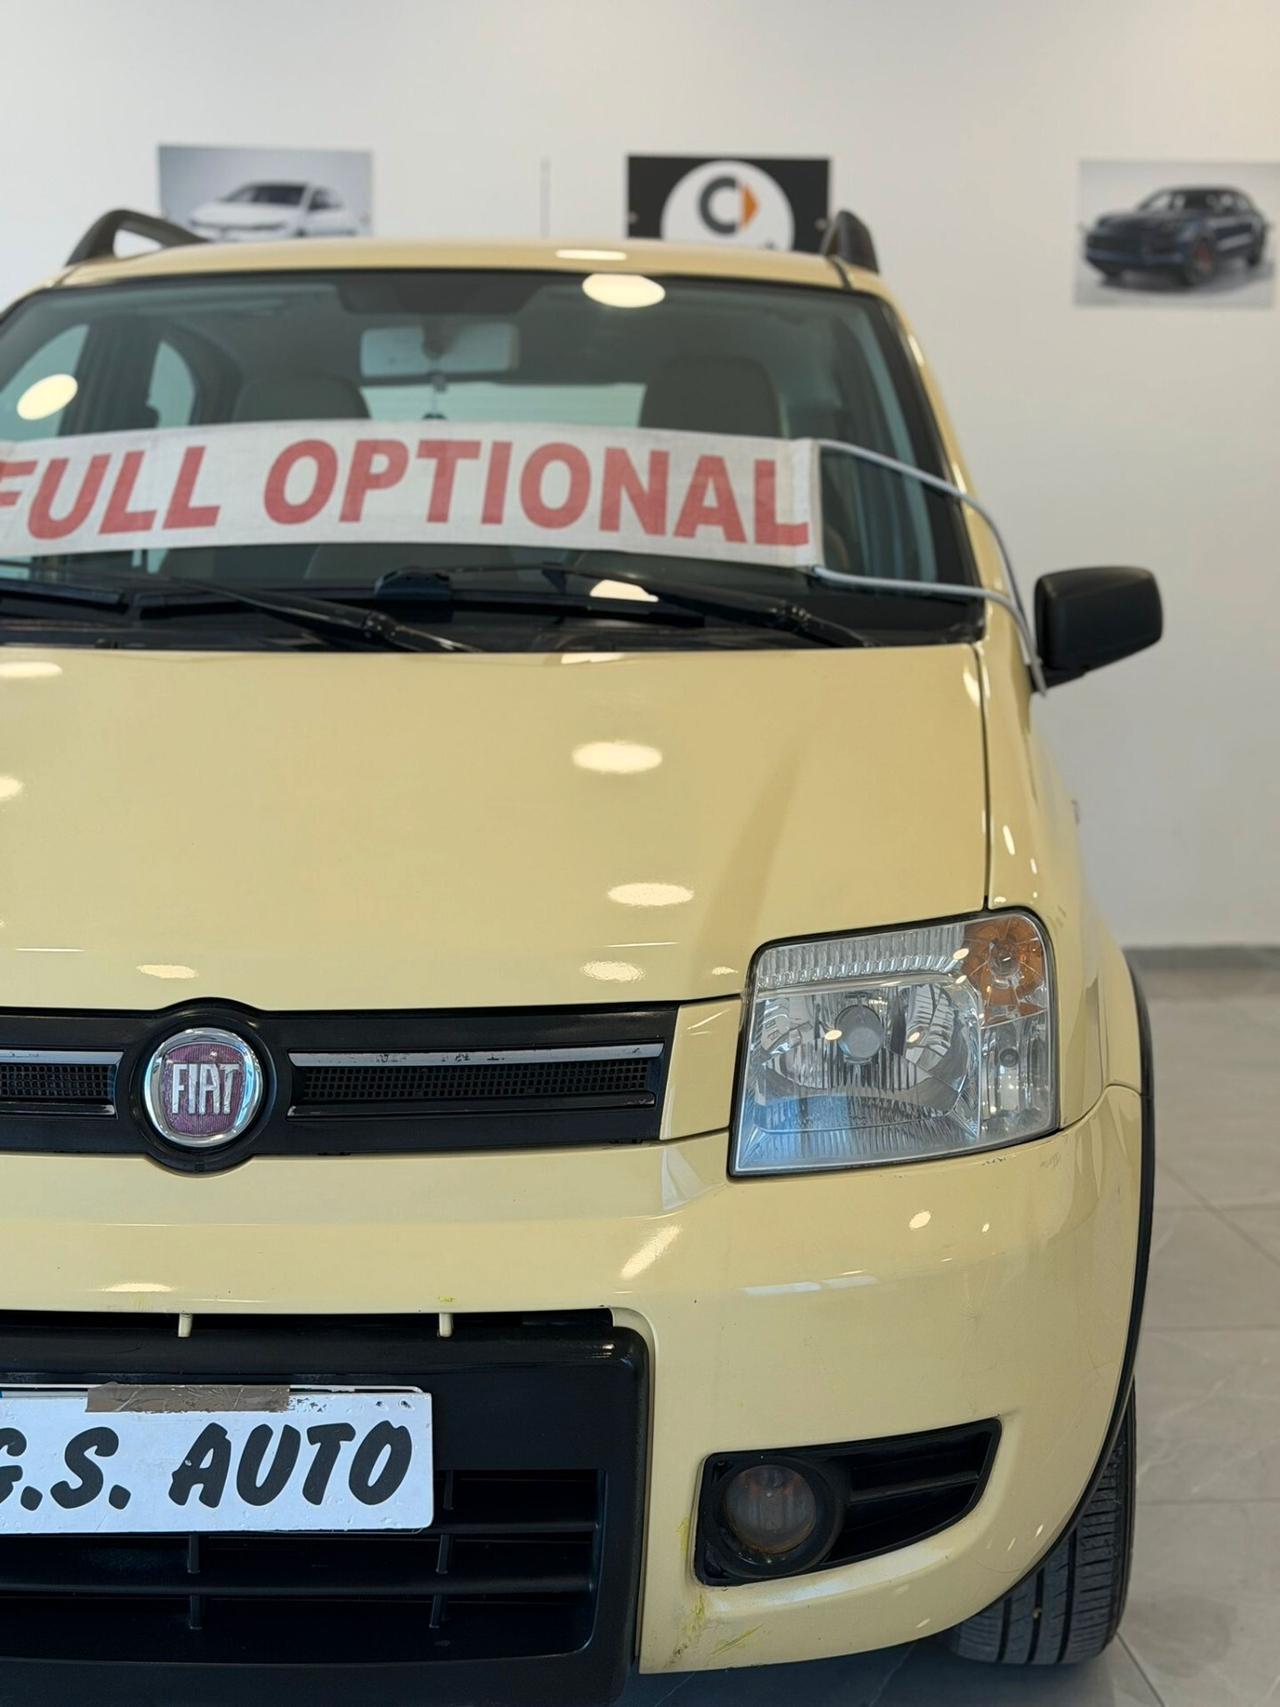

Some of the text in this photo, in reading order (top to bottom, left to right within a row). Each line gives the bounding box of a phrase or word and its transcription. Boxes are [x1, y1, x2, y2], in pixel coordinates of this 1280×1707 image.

[263, 439, 809, 546] OPTIONAL
[171, 1062, 240, 1115] FIAT
[168, 1419, 413, 1509] AUTO
